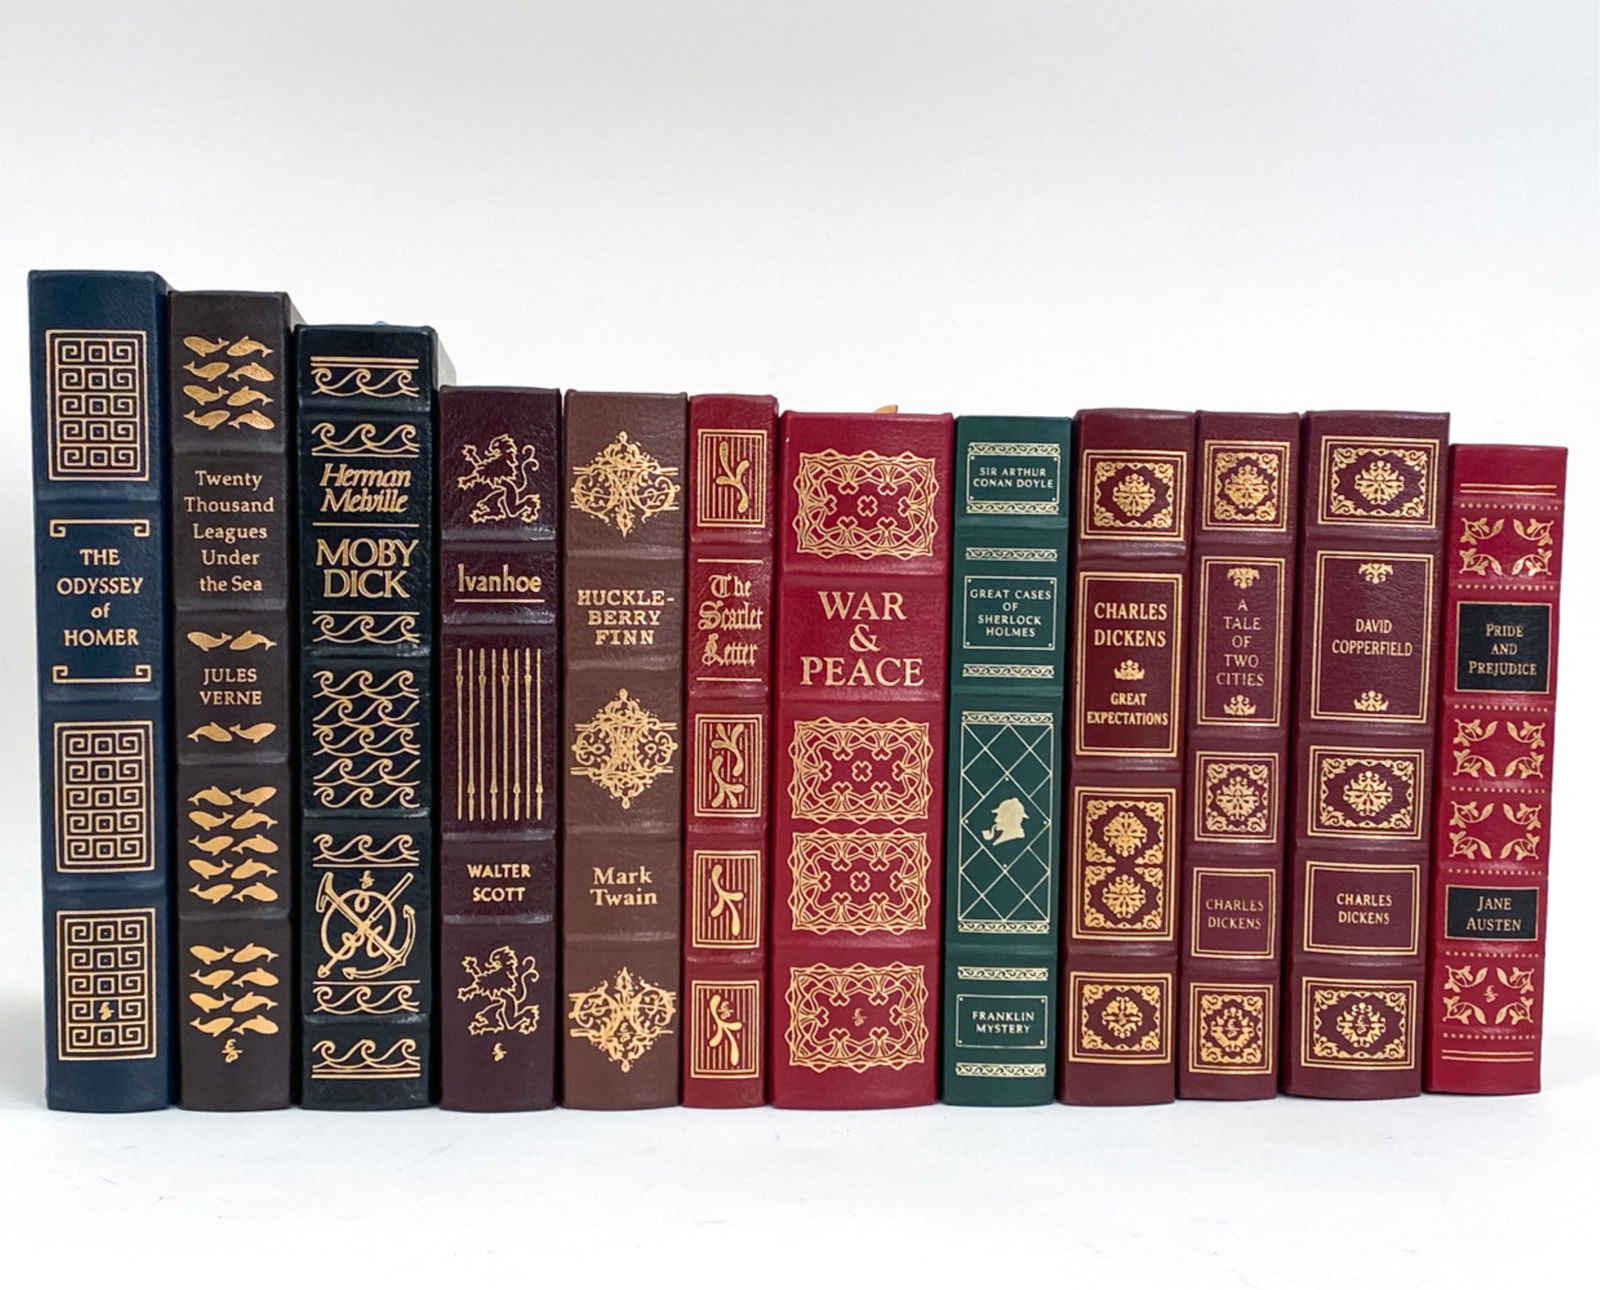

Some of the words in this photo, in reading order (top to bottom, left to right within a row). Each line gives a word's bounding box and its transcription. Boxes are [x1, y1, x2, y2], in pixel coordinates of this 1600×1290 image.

[320, 463, 411, 489] Herman
[980, 467, 997, 475] SIR
[1002, 468, 1045, 476] ARTHUR
[195, 471, 262, 491] Twenty
[973, 478, 1012, 487] CONAN
[1017, 479, 1053, 488] DOYLE
[184, 497, 274, 512] Thousand
[320, 488, 408, 514] Melville
[193, 524, 267, 543] Leagues
[80, 549, 120, 565] THE
[202, 549, 260, 565] Under
[316, 538, 419, 567] MOBY
[57, 577, 143, 594] ODYSSEY
[200, 576, 227, 591] the
[232, 576, 262, 591] Sea
[324, 569, 410, 598] DICK
[458, 564, 541, 592] Ivanhoe
[709, 574, 752, 598] The
[578, 590, 674, 606] HUCKLE-
[970, 589, 1009, 598] GREAT
[1015, 590, 1051, 599] CASES
[91, 603, 110, 618] of
[818, 592, 907, 620] WAR
[1003, 602, 1018, 611] OF
[1095, 603, 1167, 620] CHARLES
[1238, 600, 1247, 611] A
[588, 610, 661, 625] BERRY
[698, 601, 763, 630] Scarlet
[978, 615, 1041, 625] SHERLOCK
[1224, 616, 1261, 630] TALE
[986, 627, 1035, 637] HOLMES
[1356, 619, 1392, 633] DAVID
[64, 629, 139, 646] HOMER
[596, 630, 654, 645] FINN
[850, 624, 880, 651] &
[1095, 630, 1166, 647] DICKENS
[1232, 635, 1251, 648] OF
[702, 633, 758, 666] Letter
[1332, 640, 1412, 656] COPPERFIELD
[1491, 644, 1517, 655] AND
[1224, 654, 1259, 668] TWO
[203, 668, 257, 684] JULES
[801, 657, 924, 686] PEACE
[1217, 673, 1264, 686] CITIES
[200, 691, 262, 704] VERNE
[1111, 693, 1147, 705] GREAT
[1087, 711, 1169, 726] EXPECTATIONS
[467, 864, 531, 878] WALTER
[593, 866, 652, 884] Mark
[473, 887, 525, 901] SCOTT
[590, 888, 657, 905] Twain
[1337, 893, 1392, 906] CHARLES
[1206, 899, 1263, 911] CHARLES
[1208, 917, 1261, 929] DICKENS
[1339, 911, 1389, 924] DICKENS
[973, 1011, 1034, 1021] FRANKLIN
[977, 1024, 1030, 1033] MYSTERY
